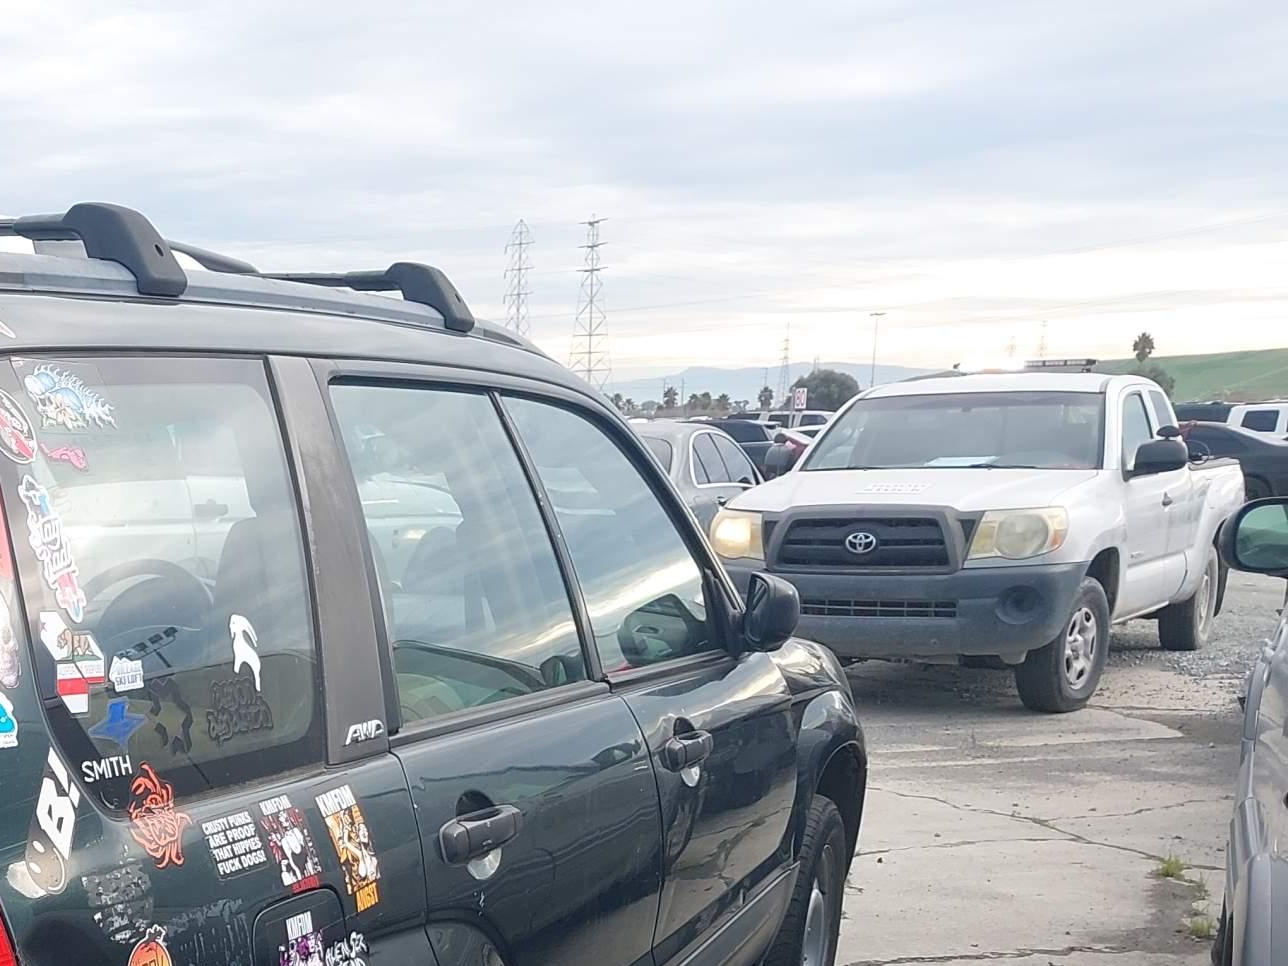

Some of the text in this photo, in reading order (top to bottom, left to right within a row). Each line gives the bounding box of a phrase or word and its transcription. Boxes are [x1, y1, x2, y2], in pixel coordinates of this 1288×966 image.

[345, 719, 385, 745] AWD
[81, 754, 133, 783] SMITH
[258, 794, 292, 816] KMFDM
[315, 784, 357, 818] KMFDM
[202, 811, 253, 836] CRUSTY PUNKS
[208, 823, 256, 849] ARE PROOF
[213, 836, 262, 862] THAT HIPPIES
[217, 849, 267, 875] FUCK DOGS!
[285, 911, 313, 941] KMFDM
